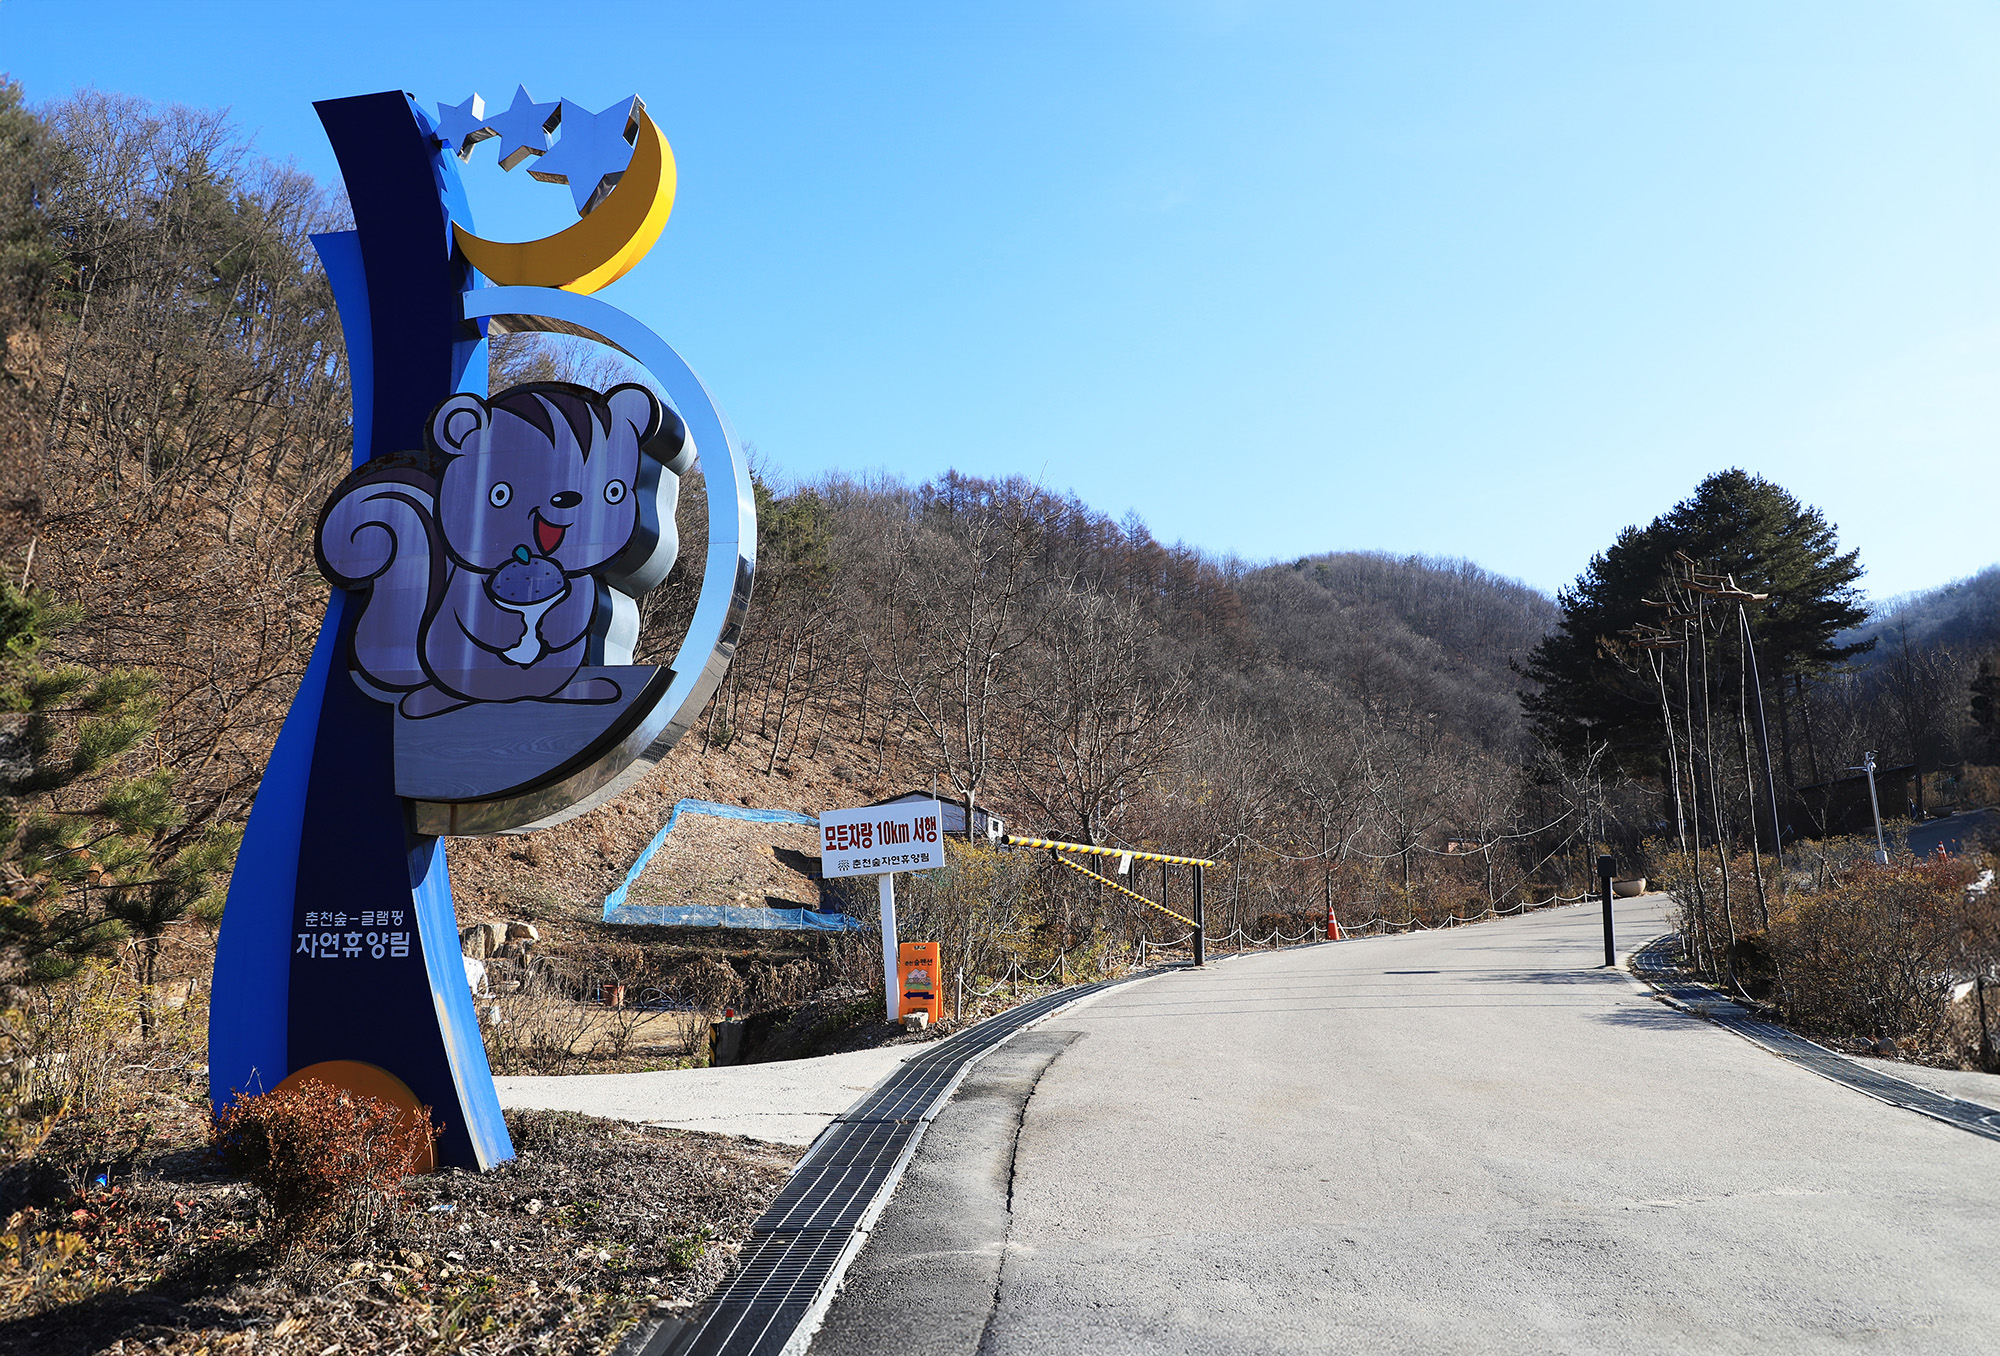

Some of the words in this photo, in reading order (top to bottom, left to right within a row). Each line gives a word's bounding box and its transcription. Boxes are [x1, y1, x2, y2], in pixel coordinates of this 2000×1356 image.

[825, 821, 873, 851] 모든차량
[876, 820, 910, 846] 10km
[913, 816, 938, 843] 서행
[852, 853, 930, 869] 춘천숲자연휴양림
[305, 910, 404, 927] 춘천숲-글램핑
[296, 931, 410, 960] 자연휴양림
